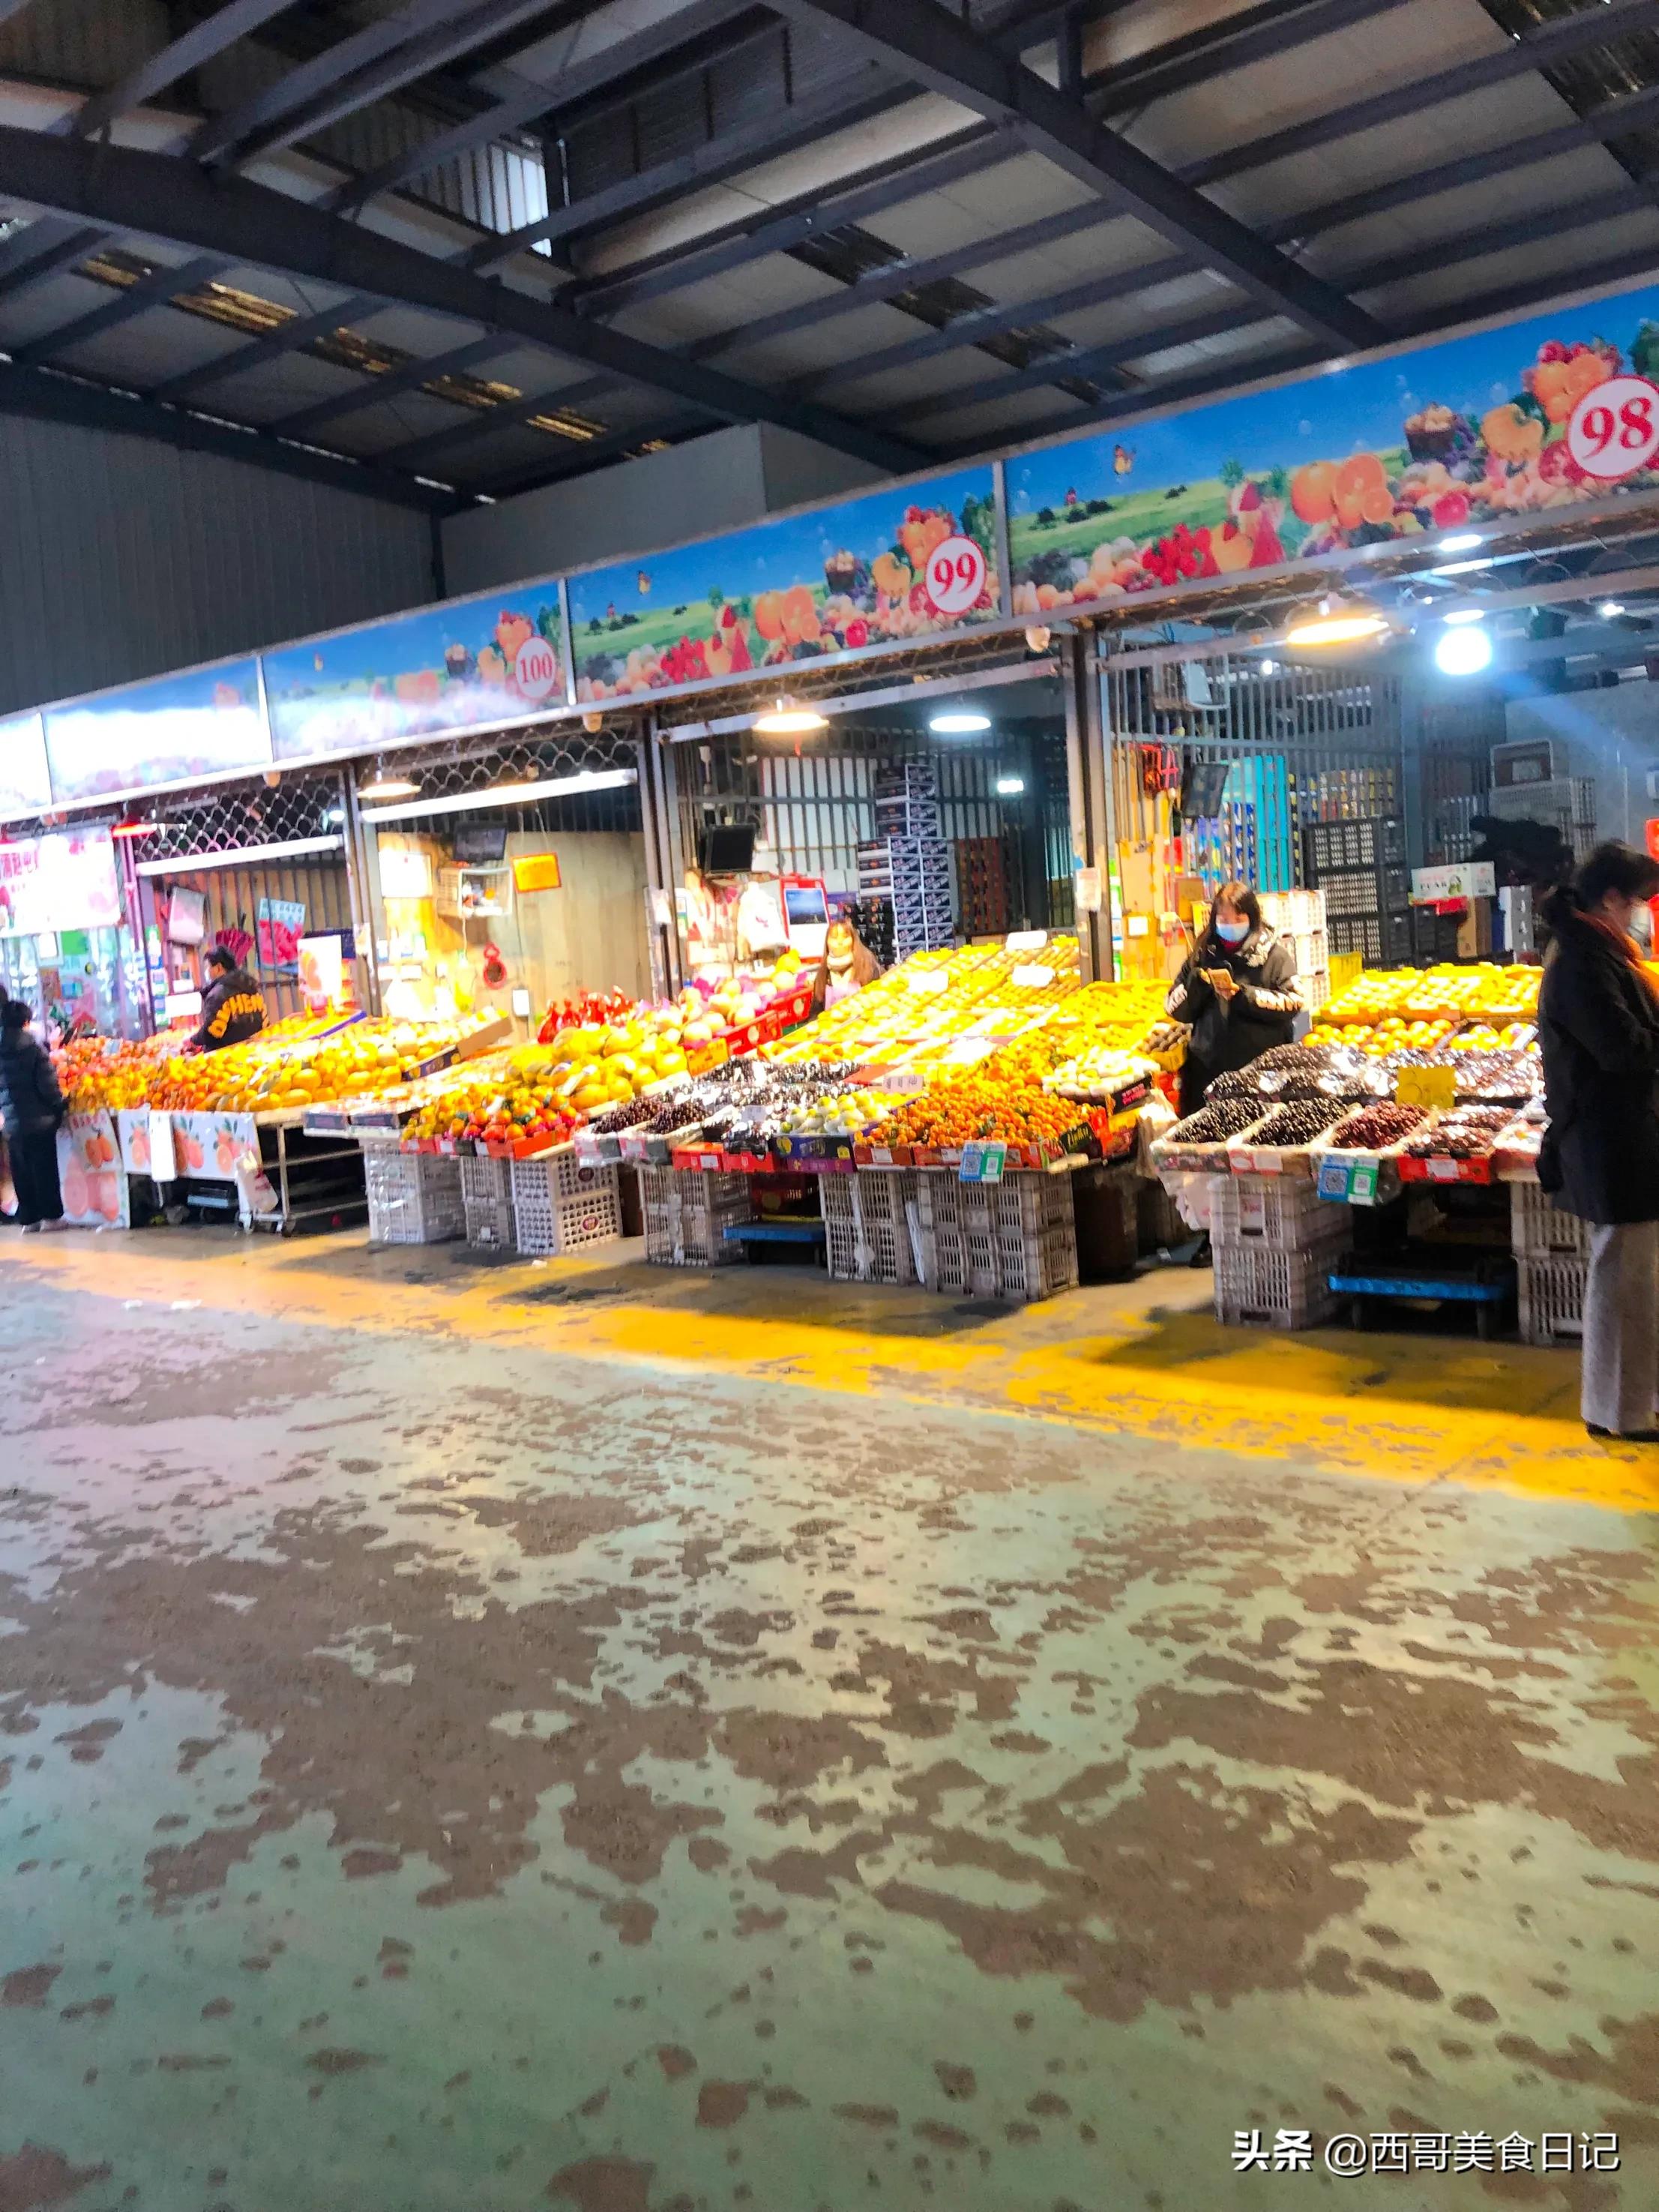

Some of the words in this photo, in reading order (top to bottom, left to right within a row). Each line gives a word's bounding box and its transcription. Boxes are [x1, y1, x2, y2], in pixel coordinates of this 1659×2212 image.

[1583, 397, 1653, 460] 98
[934, 553, 978, 598] 99
[520, 653, 553, 683] 100
